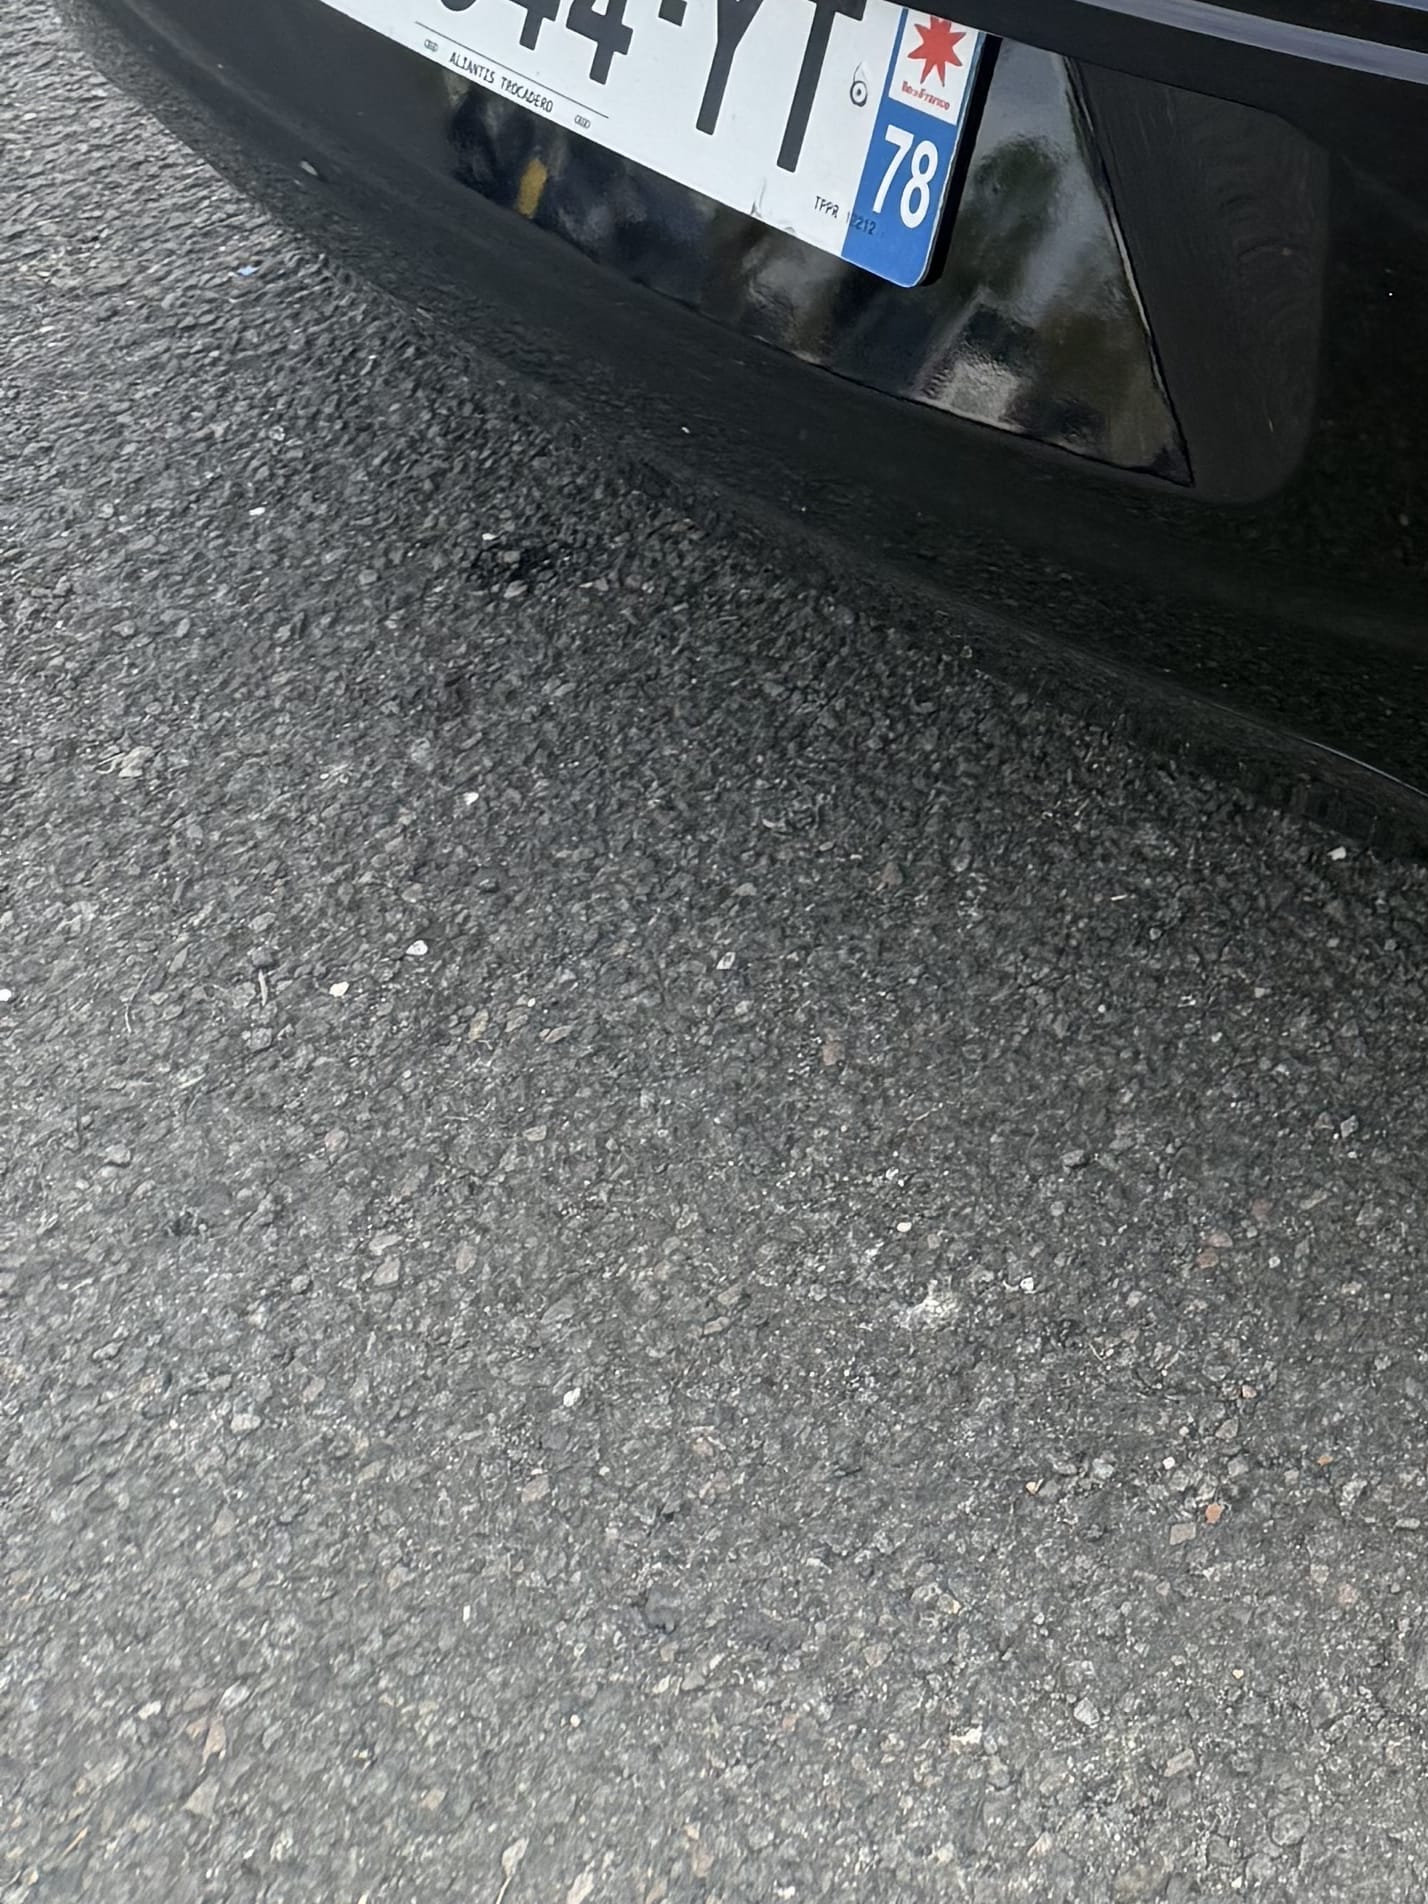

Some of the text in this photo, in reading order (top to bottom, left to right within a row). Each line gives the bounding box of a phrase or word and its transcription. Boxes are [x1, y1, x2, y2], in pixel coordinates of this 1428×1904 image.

[449, 51, 555, 114] ALIANTIS TROCADERO
[872, 123, 939, 229] 78
